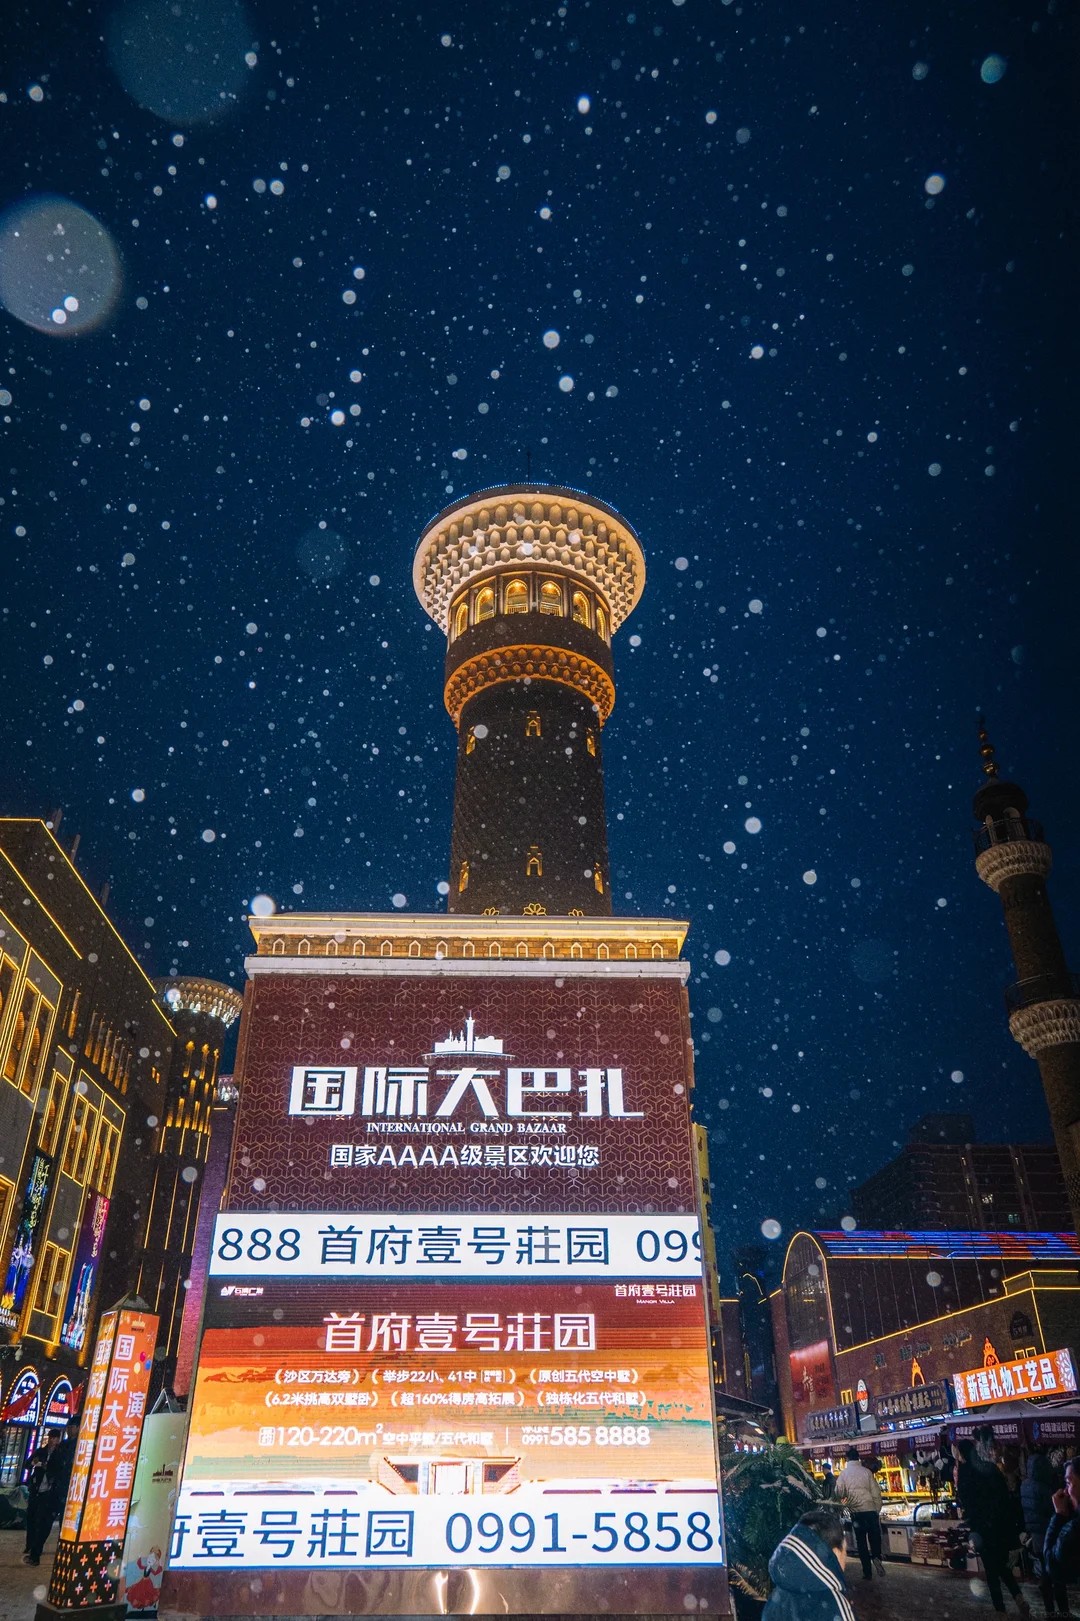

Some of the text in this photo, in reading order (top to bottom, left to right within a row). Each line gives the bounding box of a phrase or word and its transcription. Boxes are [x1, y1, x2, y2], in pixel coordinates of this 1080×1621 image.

[288, 1066, 644, 1117] 国际大巴扎
[366, 1122, 567, 1134] INTERNATIONAL GRAND BAZAAR
[330, 1144, 600, 1167] 国家AAAA级景区欢迎您
[209, 1227, 301, 1261] 888
[965, 1357, 1057, 1403] 新疆礼物工艺品
[90, 1334, 136, 1499] 国际大巴扎
[105, 1391, 147, 1540] 演艺售票
[445, 1511, 721, 1553] 0991-5858
